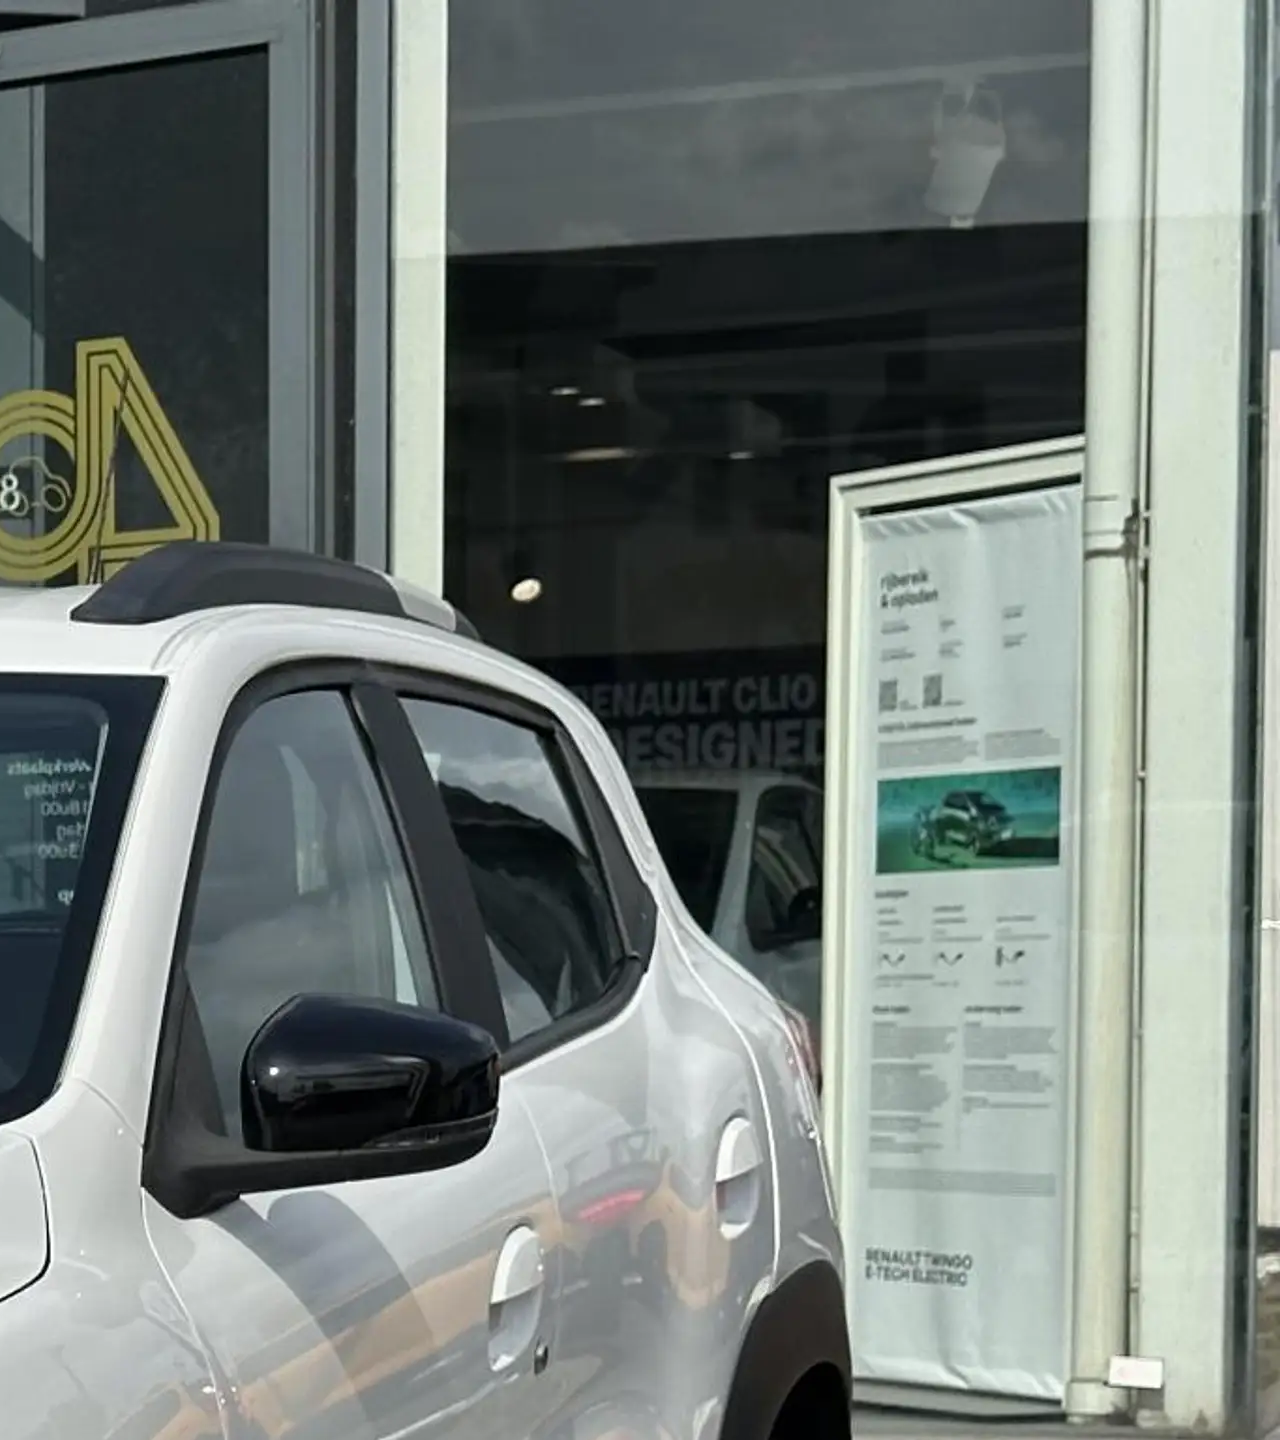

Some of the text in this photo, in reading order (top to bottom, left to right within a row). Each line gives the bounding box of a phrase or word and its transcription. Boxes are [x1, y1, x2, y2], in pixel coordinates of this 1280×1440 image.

[732, 672, 818, 714] CLIO
[865, 1248, 973, 1271] RENAULT TWINGO
